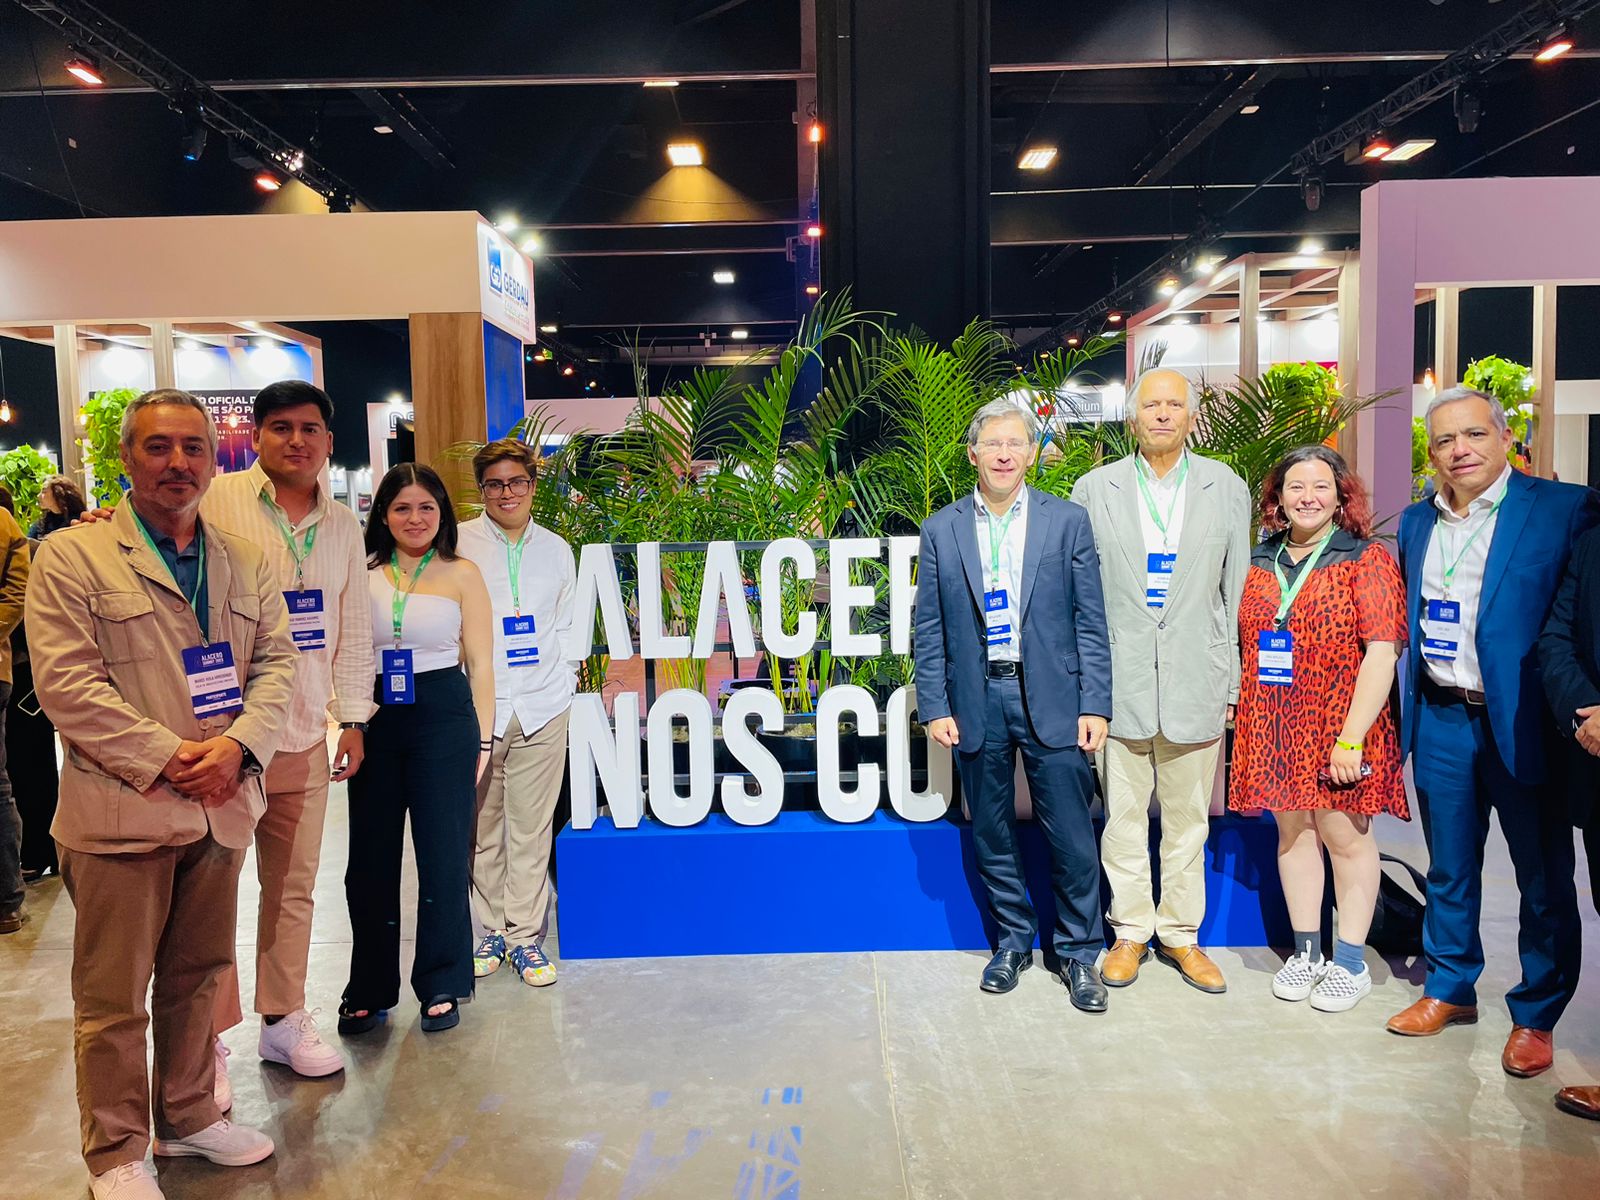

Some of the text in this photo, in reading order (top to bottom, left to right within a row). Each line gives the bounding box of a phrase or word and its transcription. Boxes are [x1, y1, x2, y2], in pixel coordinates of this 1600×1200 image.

[504, 273, 528, 306] GERDAU
[208, 396, 248, 405] OFICIAL
[221, 404, 243, 414] SÃO
[570, 685, 953, 829] NOS CO
